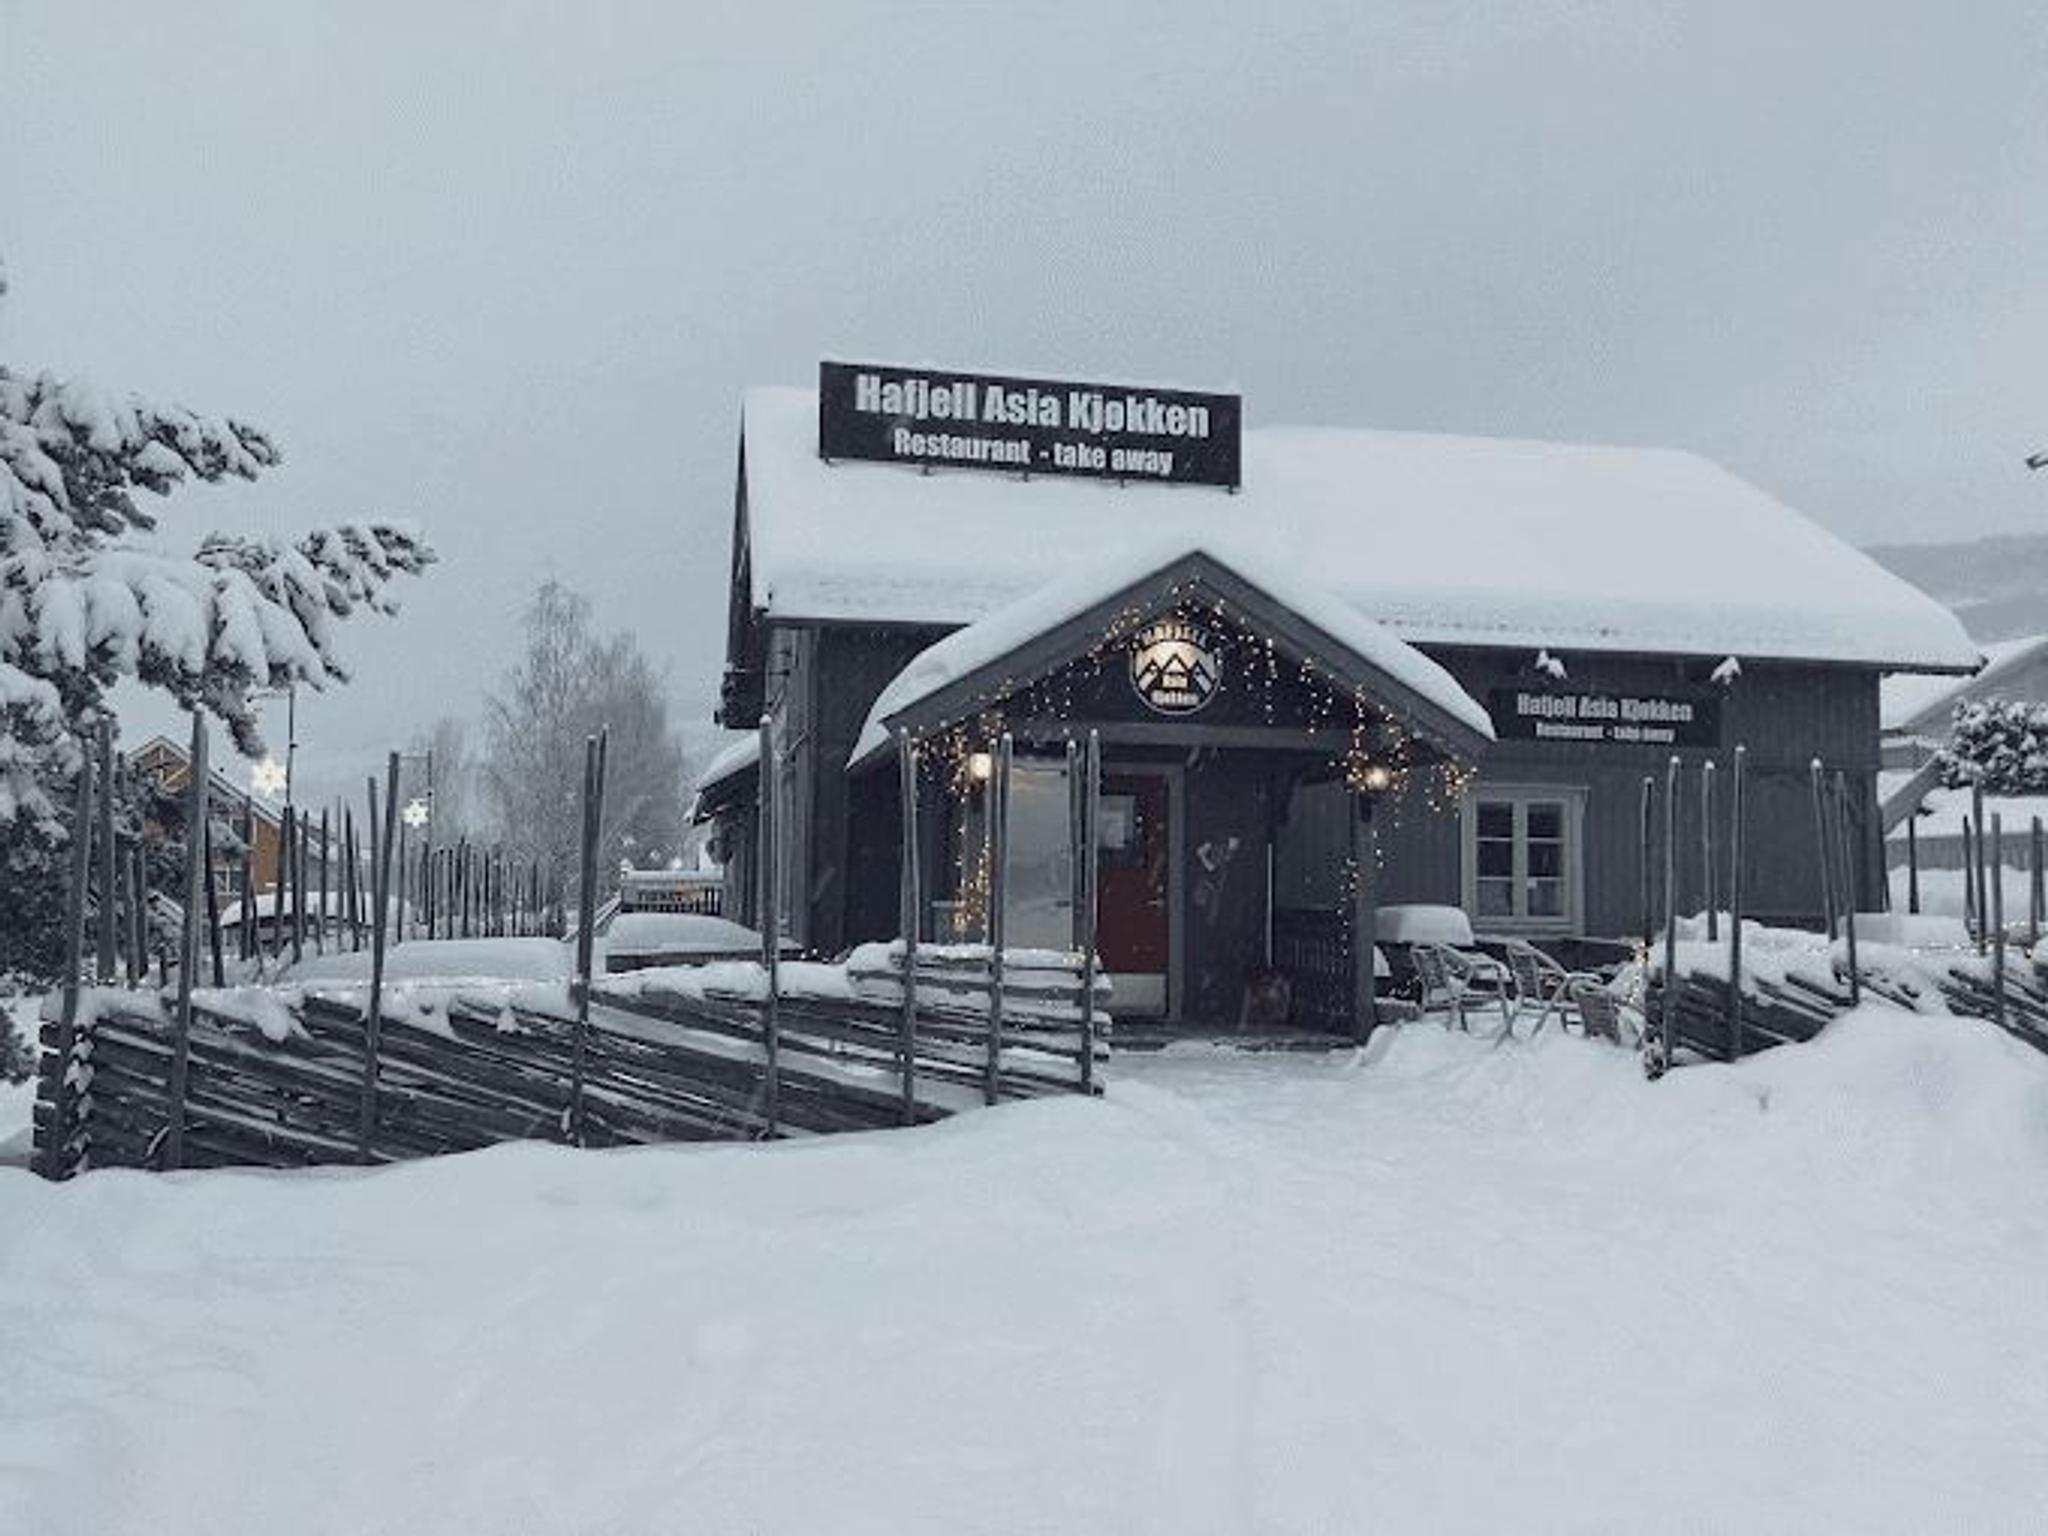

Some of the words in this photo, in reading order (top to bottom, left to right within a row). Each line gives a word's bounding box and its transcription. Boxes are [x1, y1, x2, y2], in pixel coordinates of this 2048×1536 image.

[856, 374, 976, 420] Hafjell
[983, 385, 1061, 427] Asia
[894, 427, 1030, 464] Restaurant
[1054, 442, 1106, 468] take
[1111, 449, 1173, 476] away
